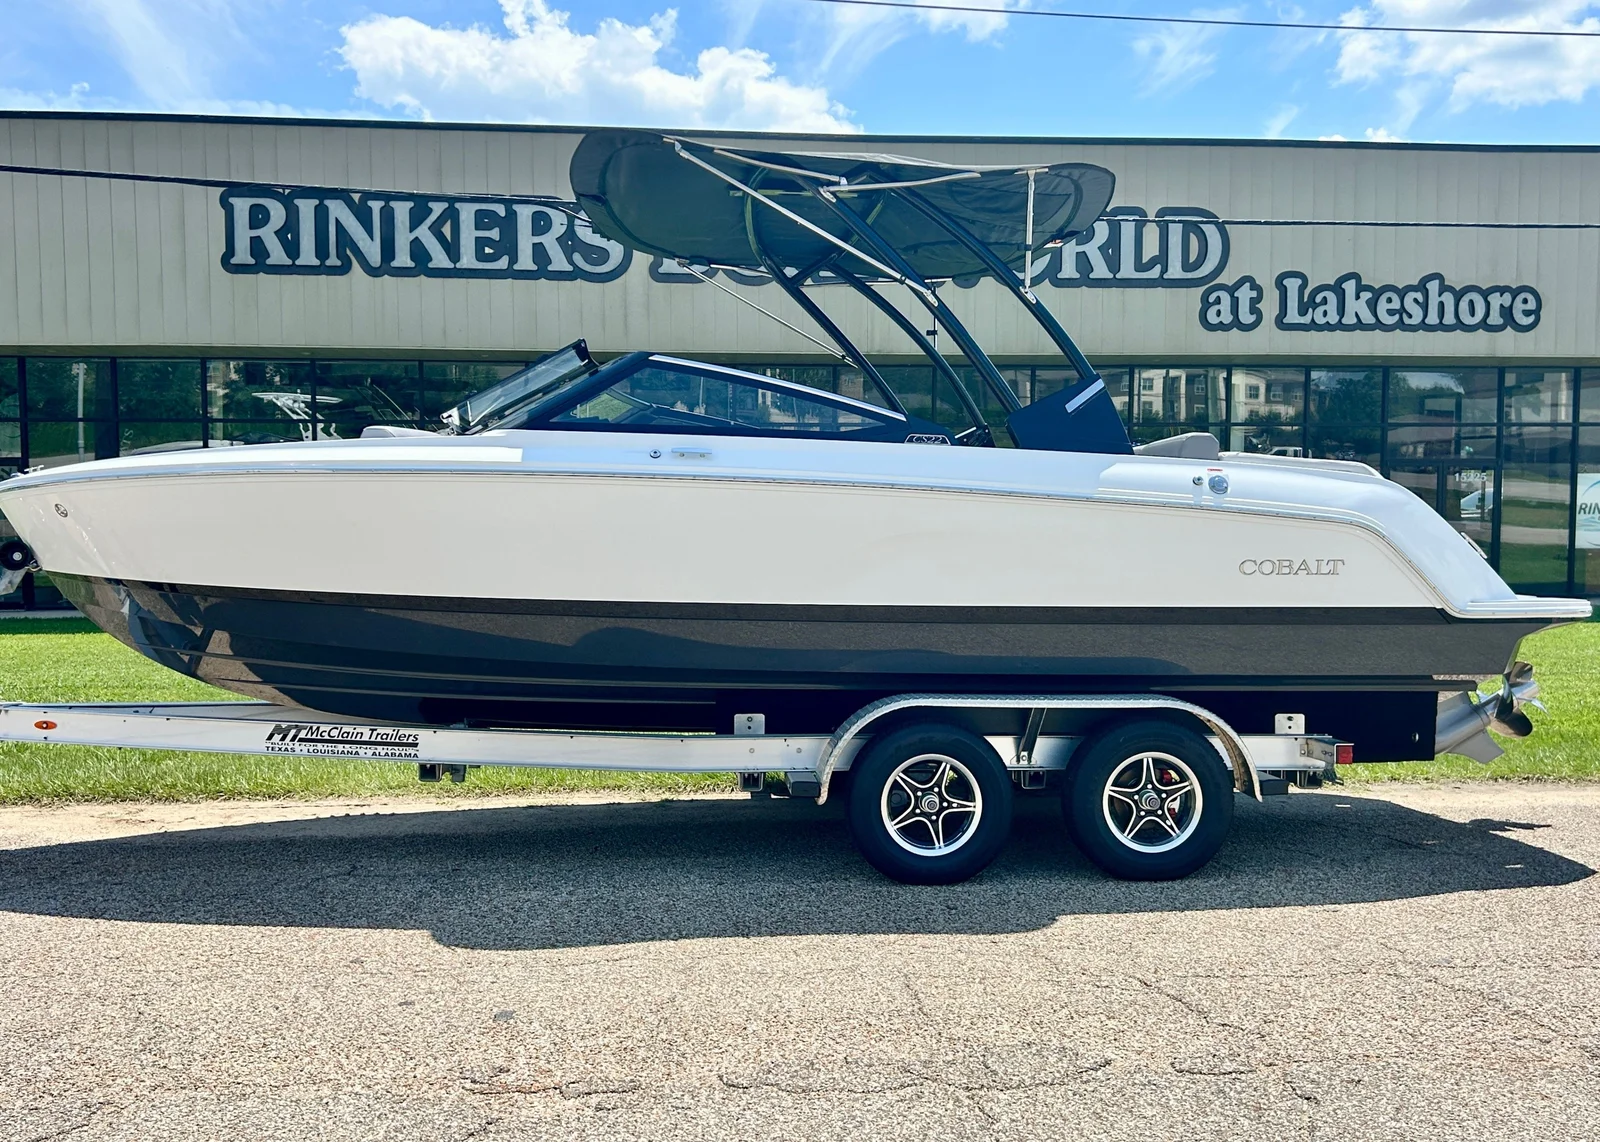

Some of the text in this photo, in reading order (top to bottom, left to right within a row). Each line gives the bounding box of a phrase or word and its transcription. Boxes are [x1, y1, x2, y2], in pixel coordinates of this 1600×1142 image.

[228, 196, 624, 274] RINKERS
[1205, 277, 1538, 326] at Lakeshore
[1454, 472, 1487, 482] 15225
[1238, 558, 1346, 576] COBALT
[305, 725, 364, 739] McClain
[368, 727, 420, 742] Trailers
[265, 745, 420, 758] TEXAS LOUISIANA ALABAMA
